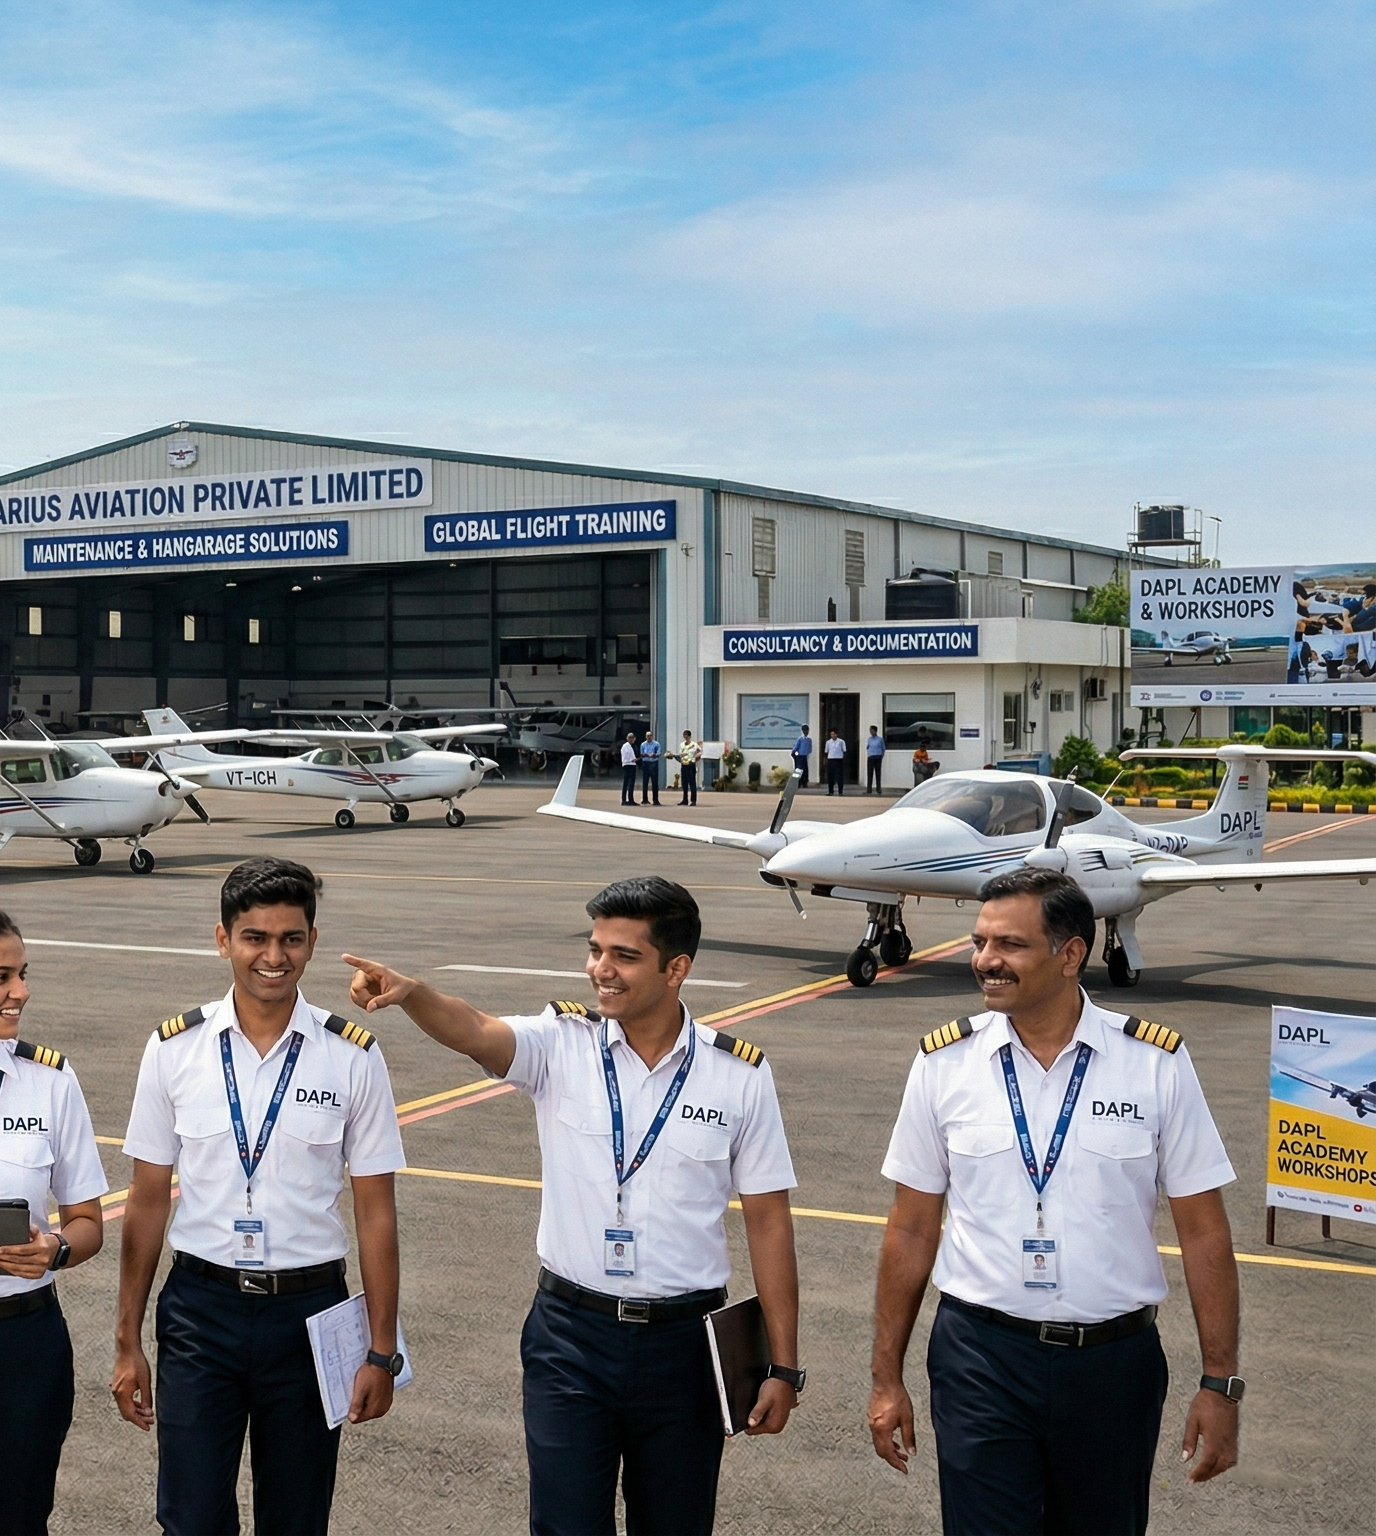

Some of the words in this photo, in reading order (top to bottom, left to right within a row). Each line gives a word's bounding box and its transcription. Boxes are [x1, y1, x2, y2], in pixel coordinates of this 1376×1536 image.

[68, 485, 185, 521] AVIATION
[193, 476, 304, 512] PRIVATE
[311, 467, 424, 505] LIMITED
[432, 519, 501, 544] GLOBAL
[506, 515, 571, 540] FLIGHT
[575, 509, 666, 536] TRAINING
[32, 539, 133, 564] MAINTENANCE
[137, 539, 148, 559] &
[152, 533, 245, 558] HANGARAGE
[249, 528, 339, 553] SOLUTIONS
[1140, 578, 1187, 597] DAPL
[1192, 575, 1282, 595] ACADEMY
[1140, 602, 1153, 620] &
[1158, 599, 1274, 620] WORKSHOPS
[728, 635, 829, 654] CONSULTANCY
[833, 636, 843, 652] &
[847, 632, 972, 651] DOCUMENTATION
[226, 770, 277, 785] VT-ICH
[1220, 810, 1261, 834] DAPL
[1278, 1024, 1331, 1045] DAPL
[295, 1088, 342, 1107] DAPL
[681, 1104, 728, 1127] DAPL
[1092, 1100, 1145, 1120] DAPL
[3, 1117, 49, 1132] DAPL
[1278, 1119, 1327, 1140] DAPL
[1277, 1139, 1368, 1165] ACADEMY
